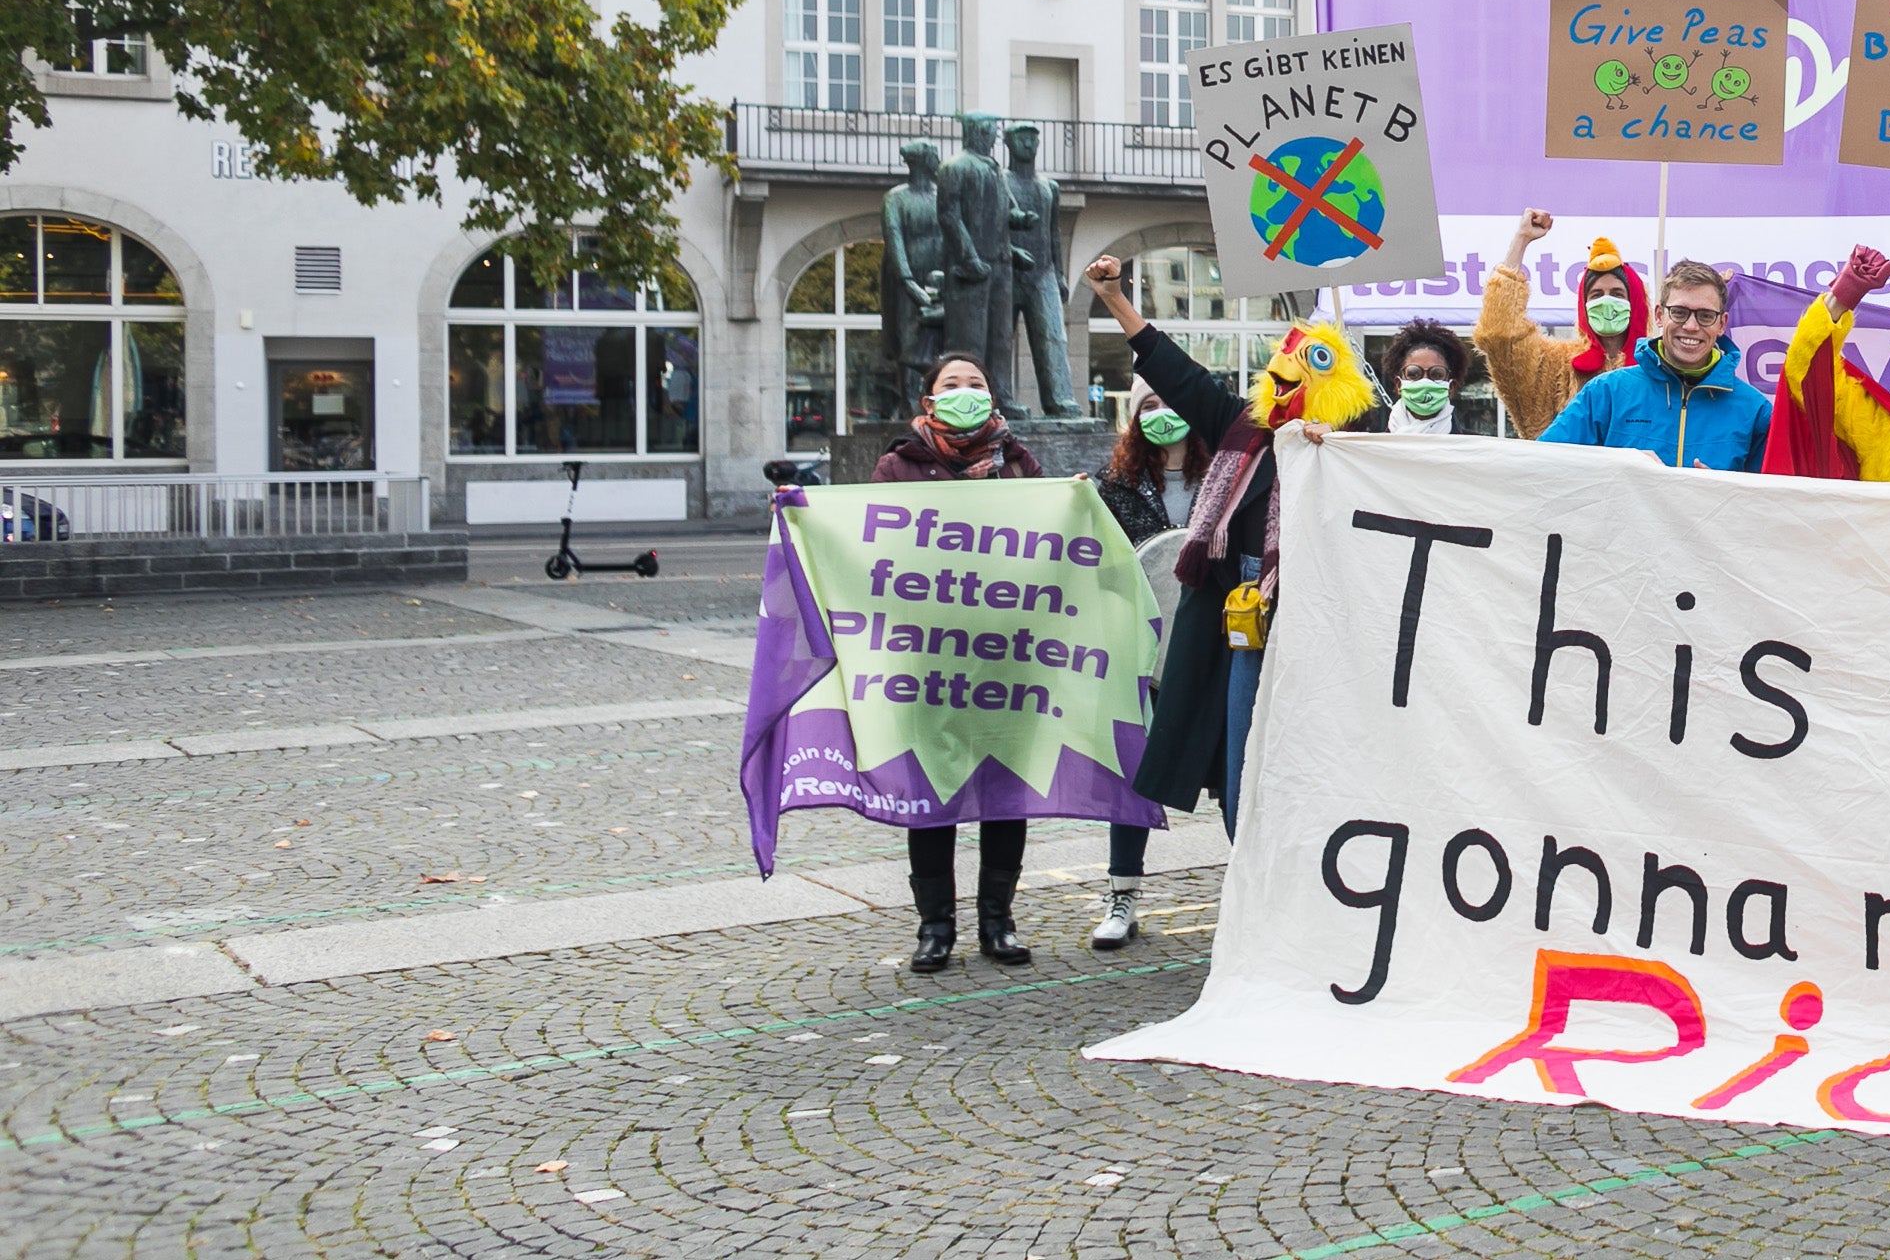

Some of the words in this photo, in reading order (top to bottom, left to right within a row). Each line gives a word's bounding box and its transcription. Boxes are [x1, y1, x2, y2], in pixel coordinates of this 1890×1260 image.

[1569, 4, 1664, 46] Give
[1681, 7, 1769, 49] Peas
[1199, 61, 1232, 87] ES
[1205, 84, 1378, 170] PLANET
[1383, 102, 1417, 142] B
[1573, 114, 1595, 139] a
[1621, 104, 1759, 141] chance
[862, 503, 1103, 566] Pfanne
[870, 558, 1078, 617] fetten.
[827, 608, 1109, 680] Planeten
[1352, 509, 1812, 760] This
[852, 670, 1063, 718] retten.
[823, 746, 853, 772] the
[1320, 817, 1799, 1007] gonna
